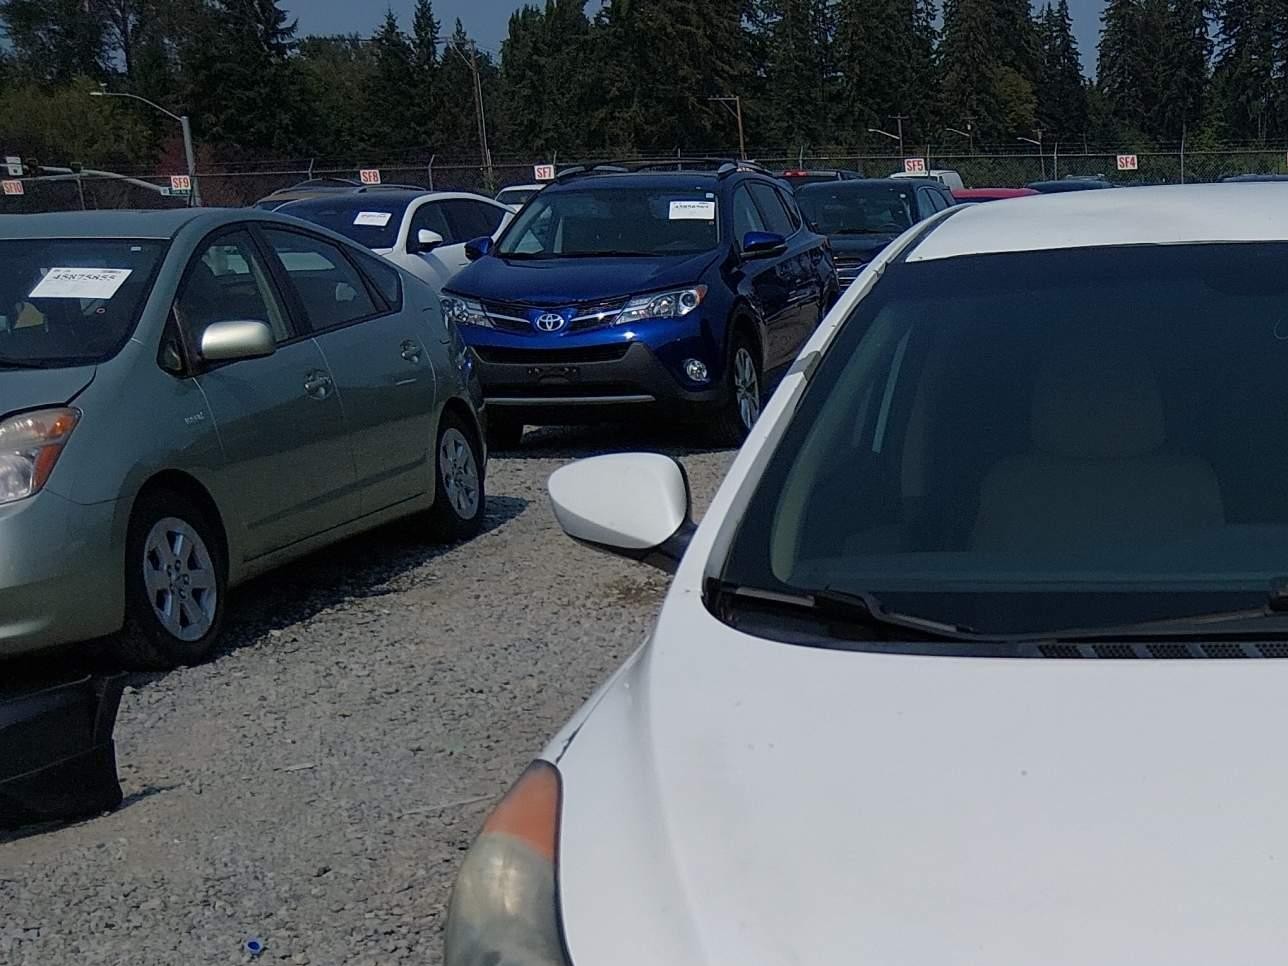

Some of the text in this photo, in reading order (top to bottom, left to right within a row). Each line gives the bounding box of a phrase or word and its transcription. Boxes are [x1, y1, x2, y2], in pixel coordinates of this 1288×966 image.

[906, 160, 923, 171] SF5
[1119, 156, 1135, 168] SF4
[362, 171, 378, 182] SF8
[172, 177, 189, 188] SF9
